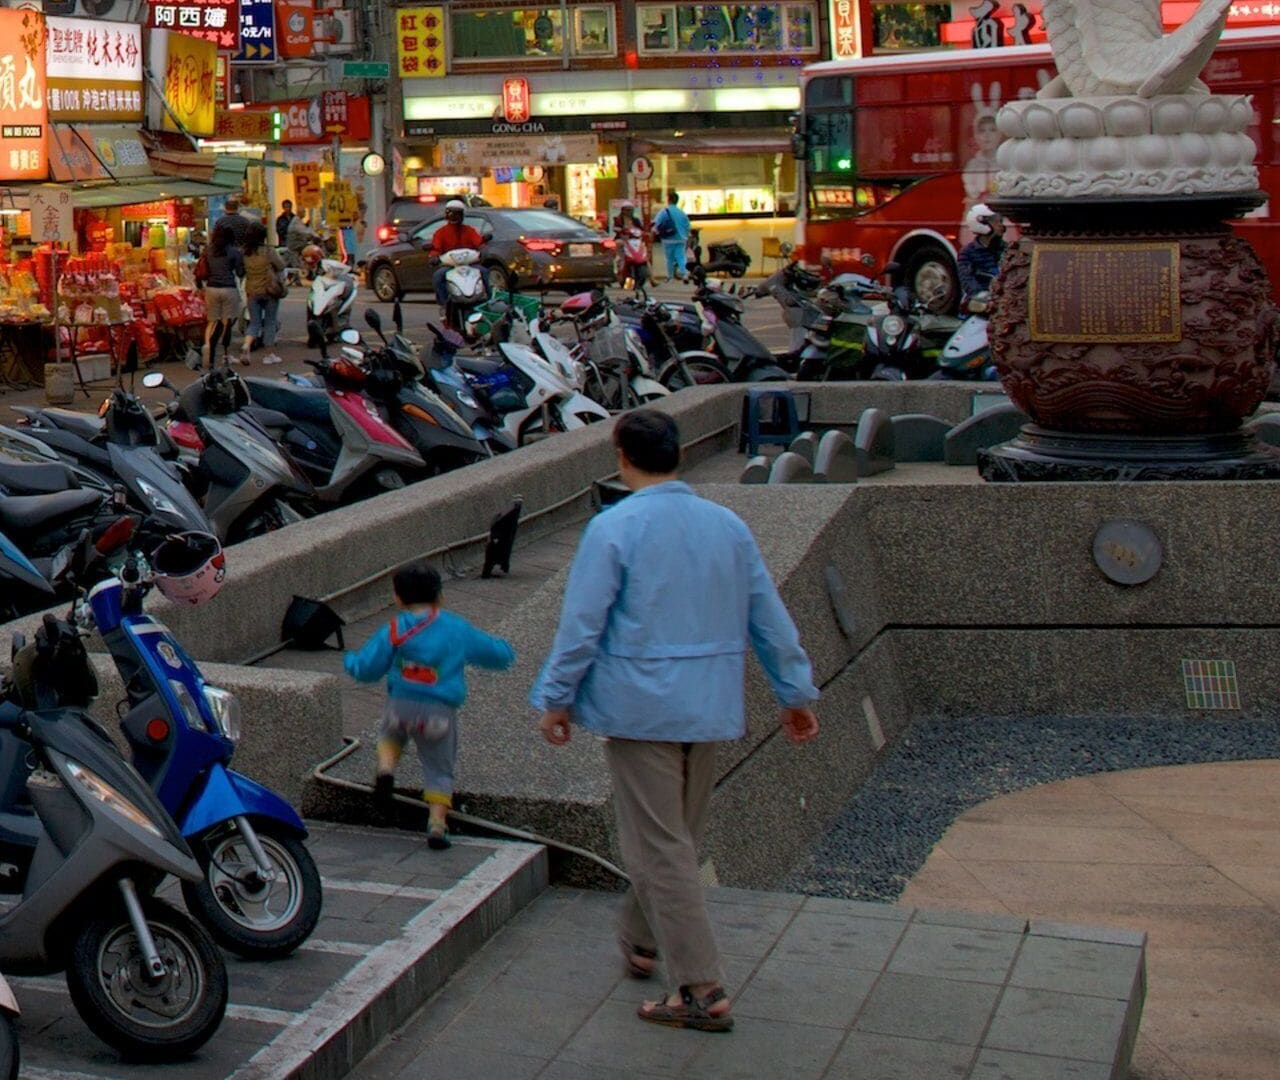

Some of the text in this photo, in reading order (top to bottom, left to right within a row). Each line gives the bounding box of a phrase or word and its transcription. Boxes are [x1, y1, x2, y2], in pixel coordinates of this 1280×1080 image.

[240, 26, 272, 38] 0元/H
[400, 14, 419, 73] 紅包袋
[492, 122, 545, 134] GONG CHA
